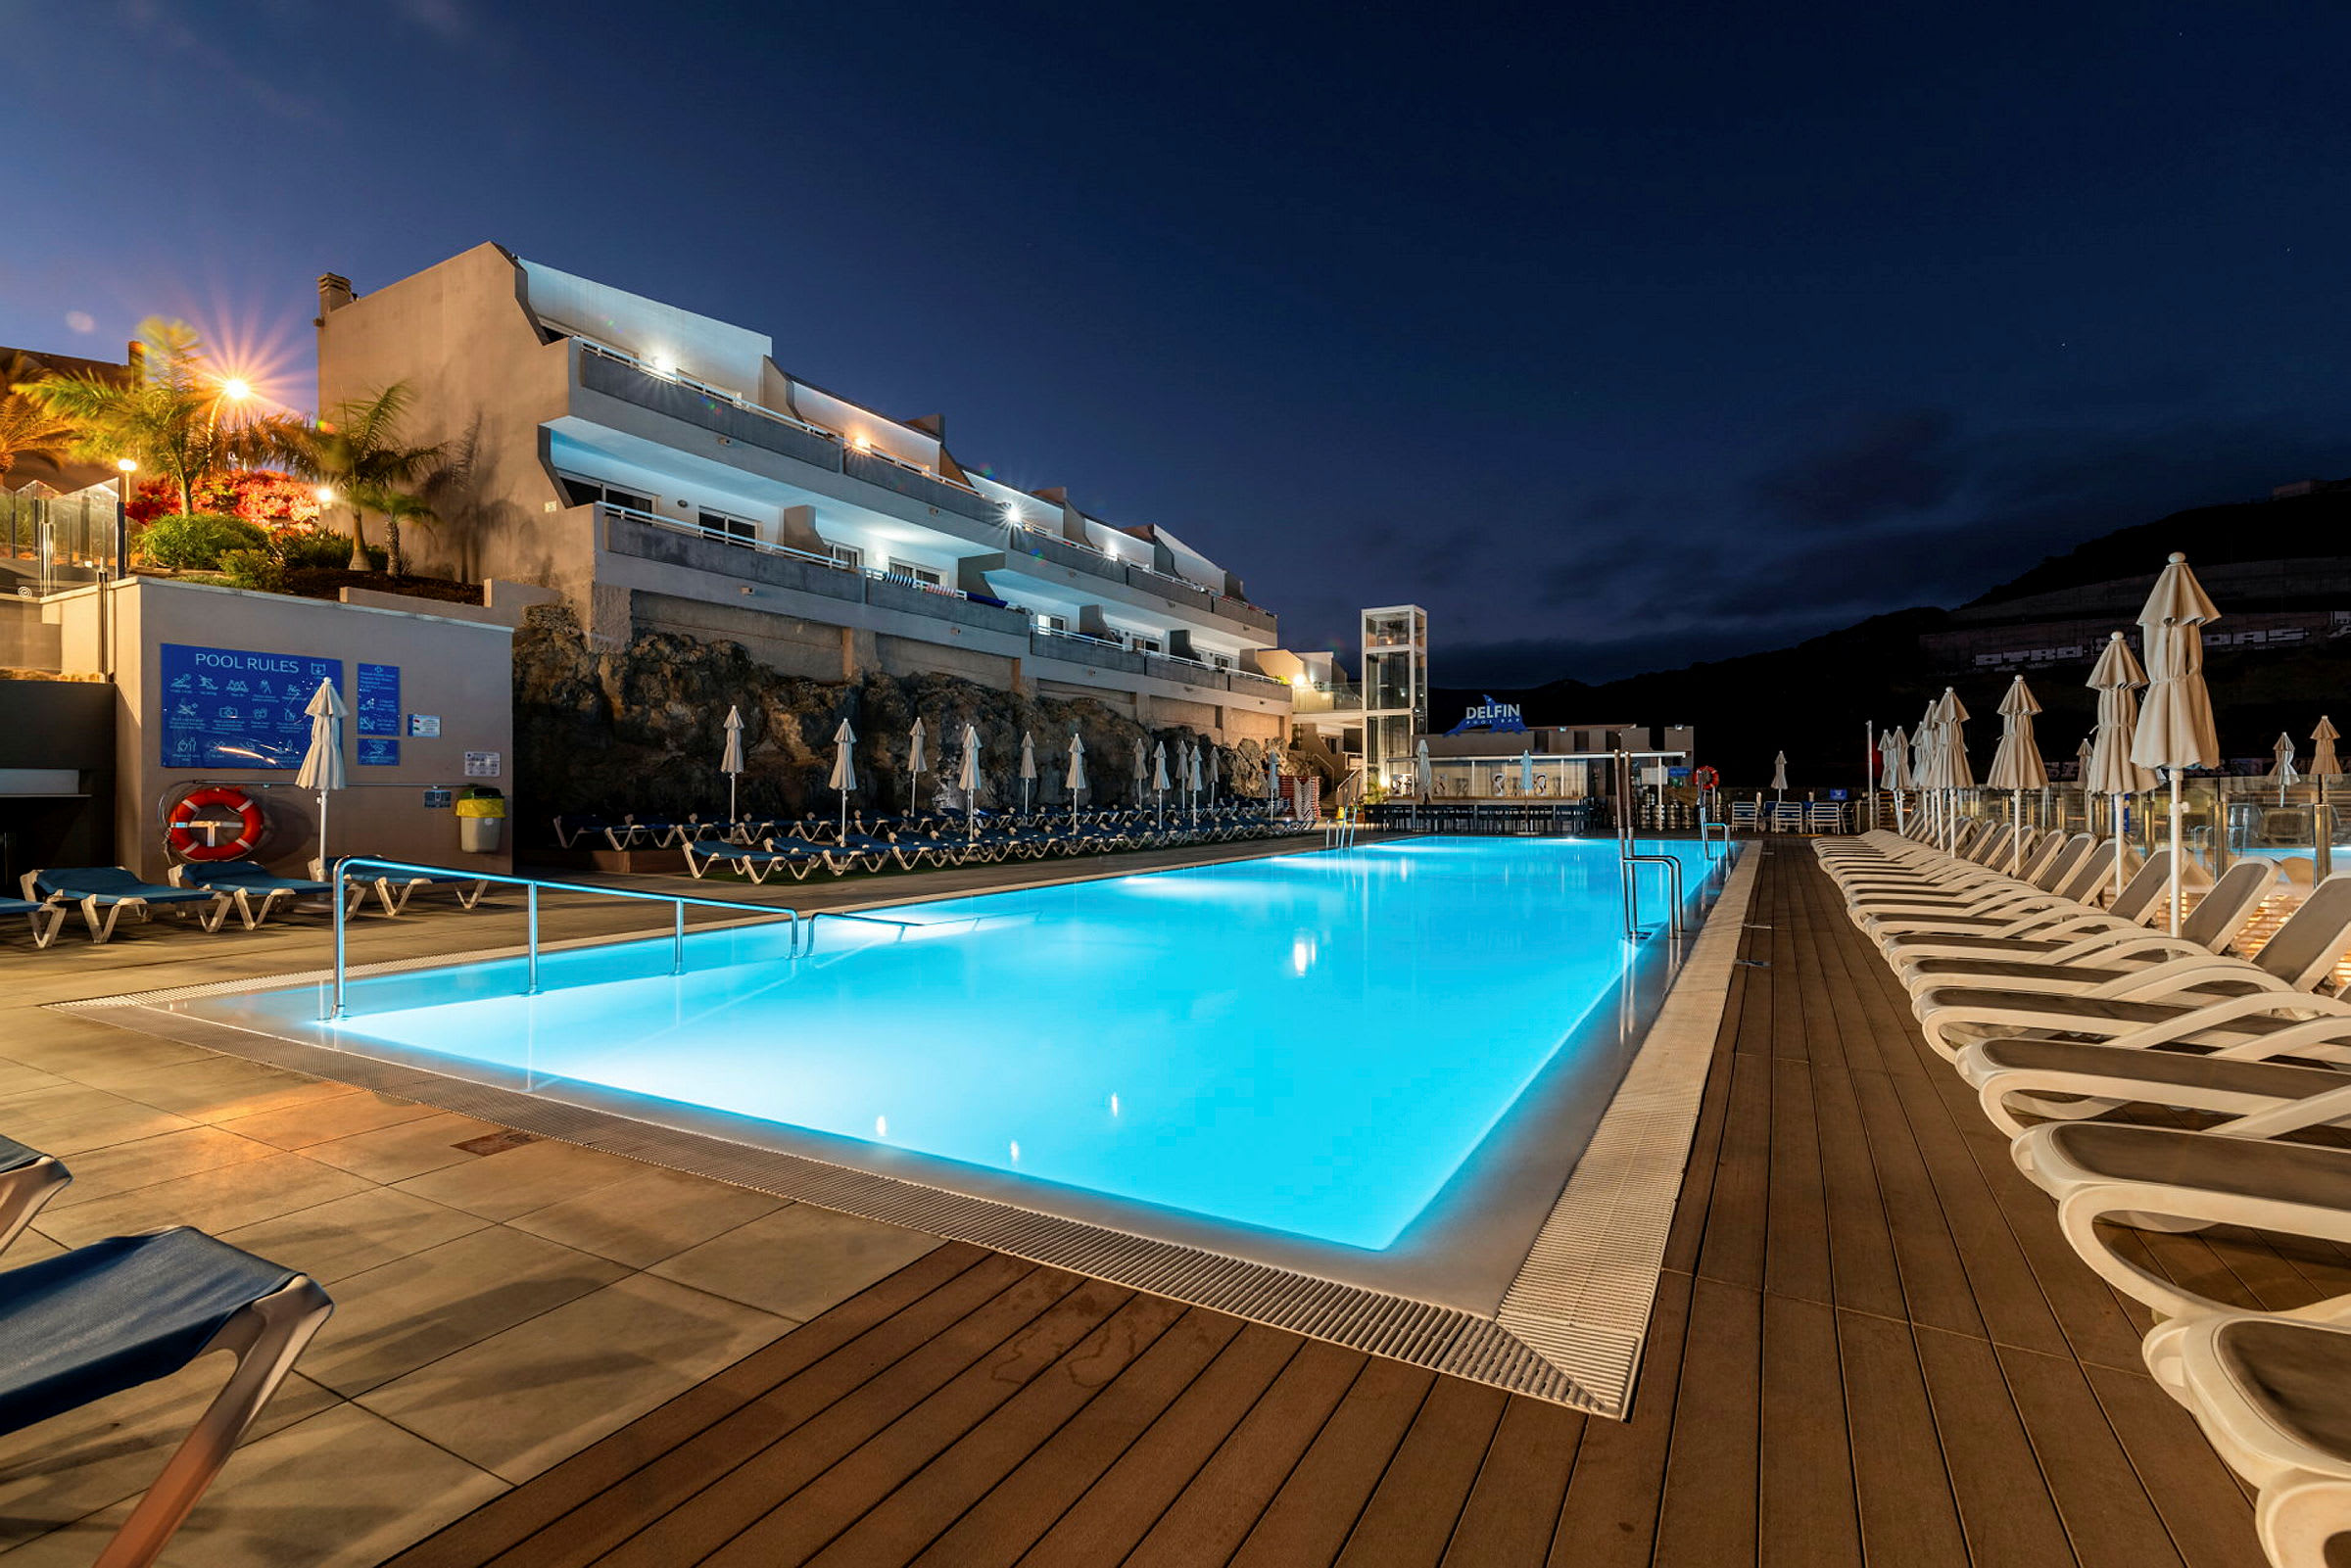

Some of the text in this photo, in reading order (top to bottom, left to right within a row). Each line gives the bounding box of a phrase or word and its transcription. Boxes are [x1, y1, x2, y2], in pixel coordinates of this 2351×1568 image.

[196, 653, 300, 674] POOL RULES
[1465, 704, 1520, 719] DELFIN
